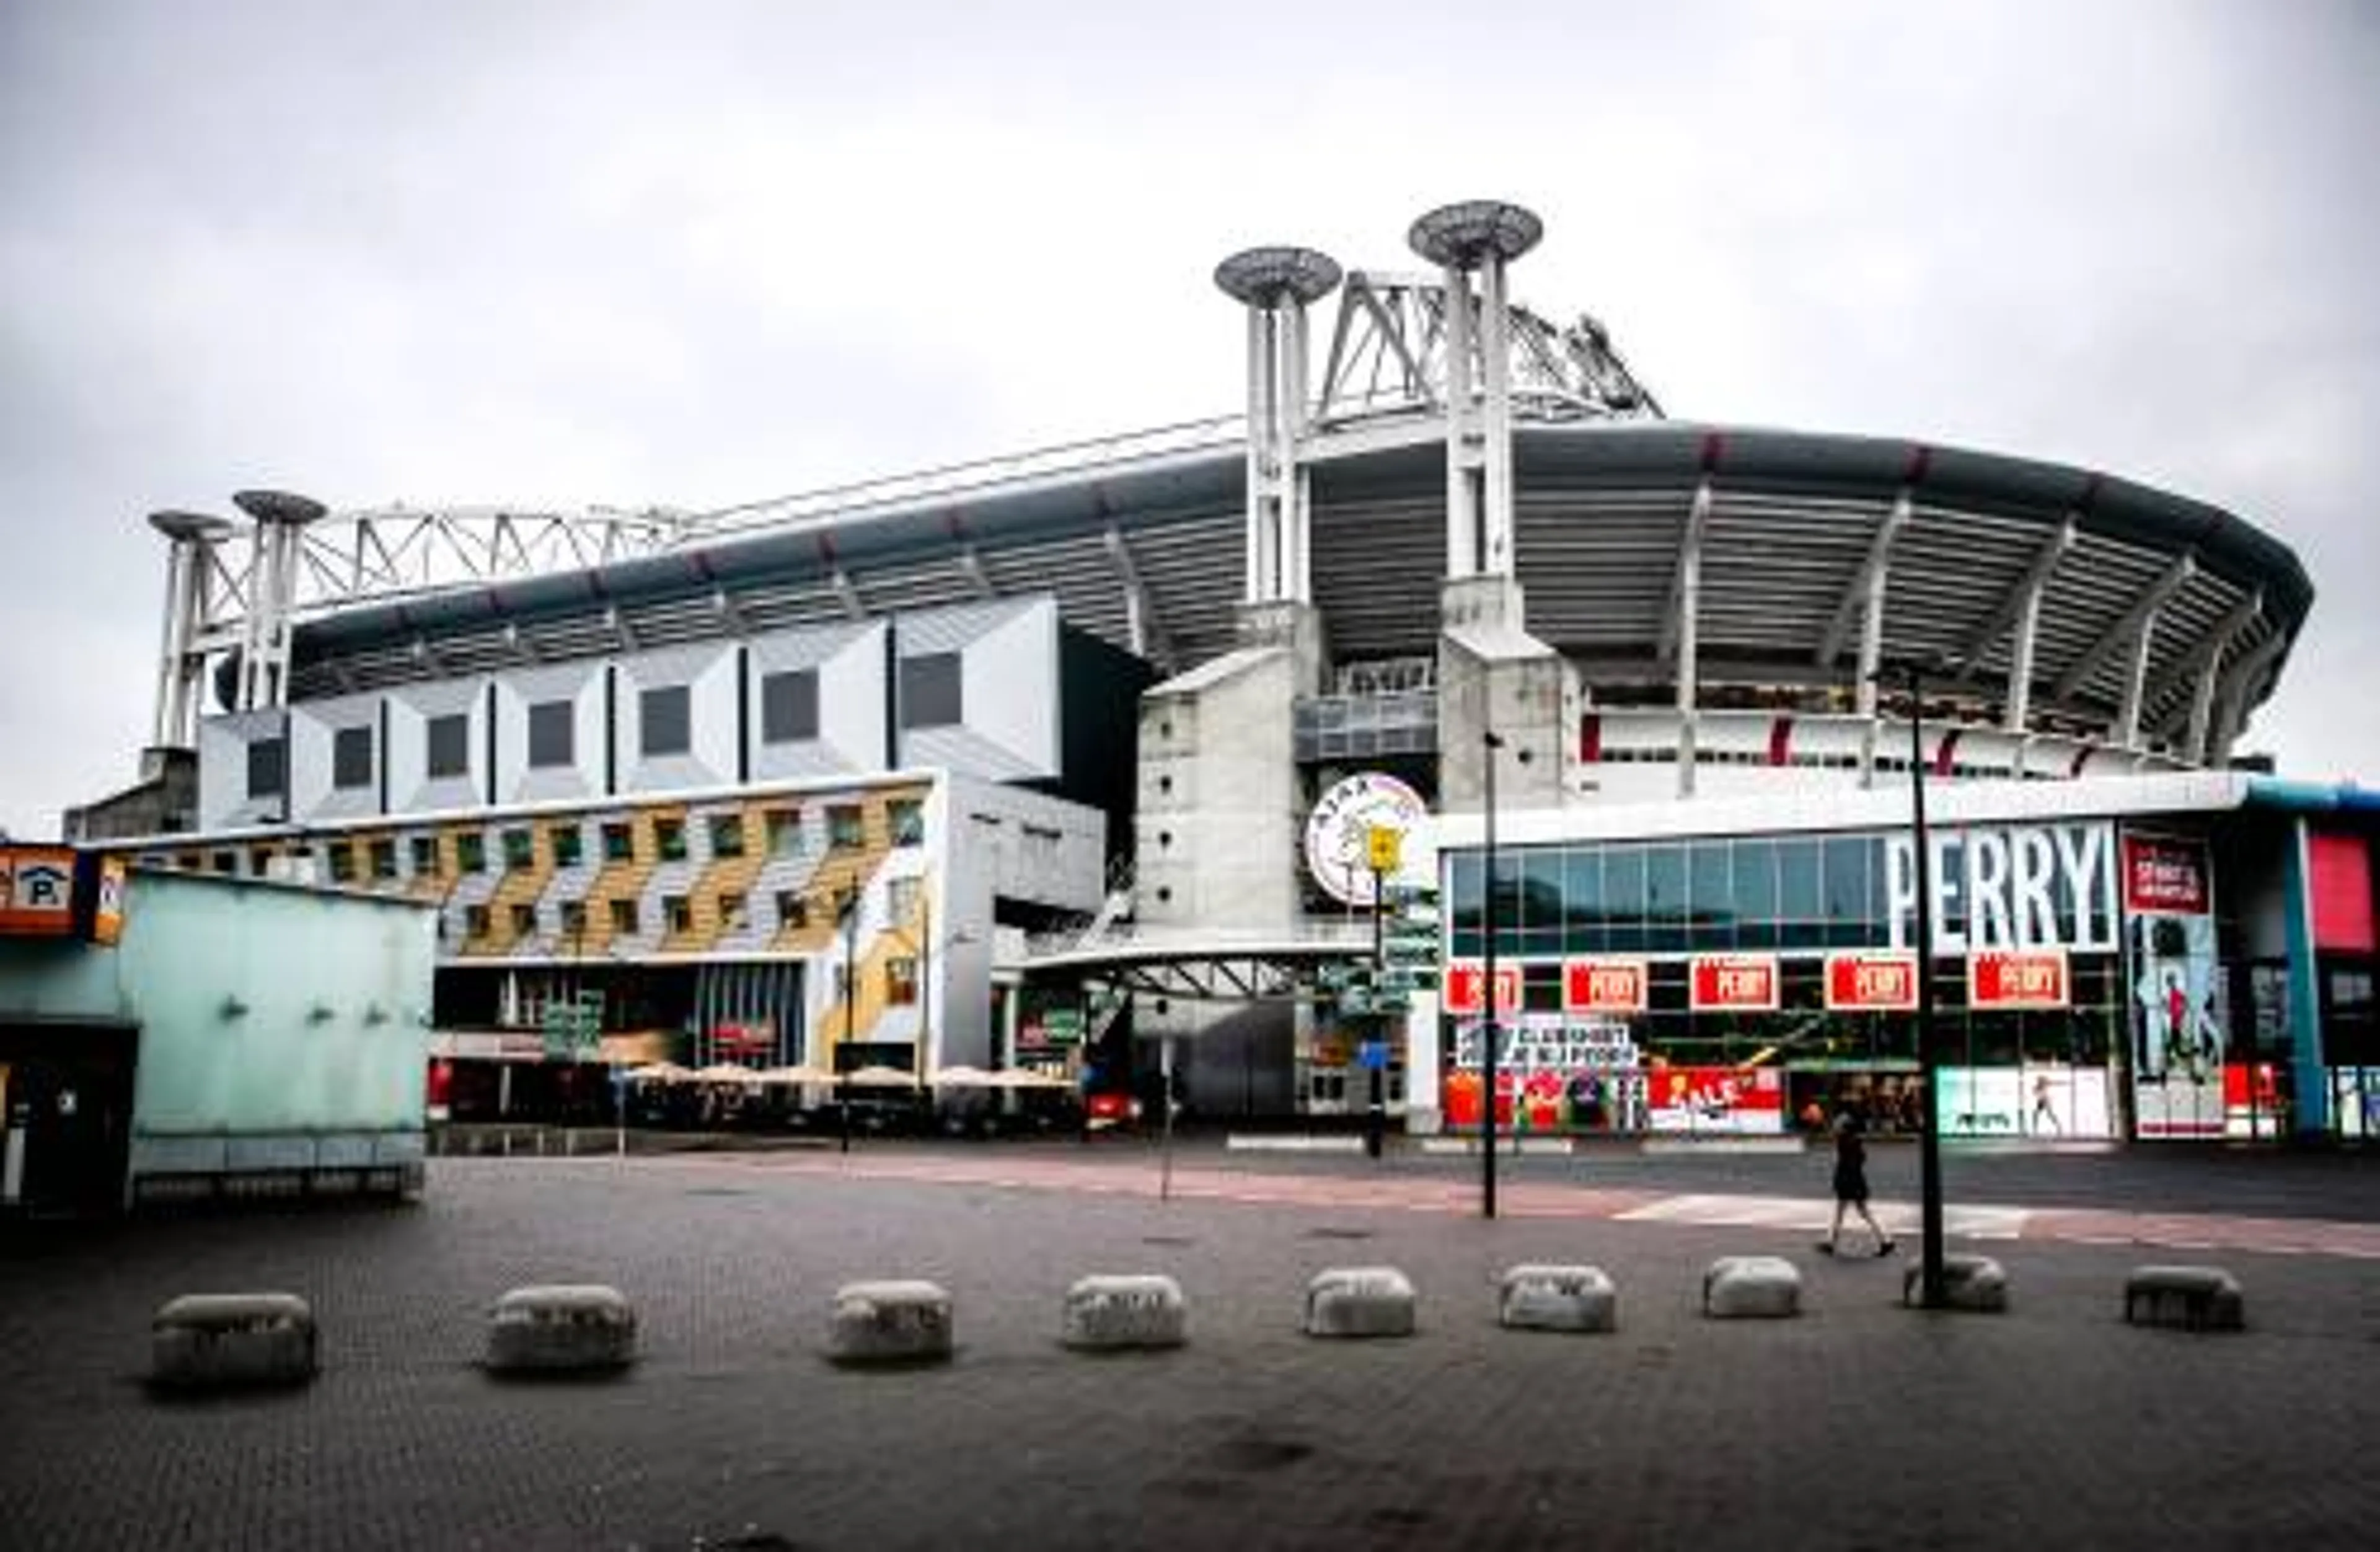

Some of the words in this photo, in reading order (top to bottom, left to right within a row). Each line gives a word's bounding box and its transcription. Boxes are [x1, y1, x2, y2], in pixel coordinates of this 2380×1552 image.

[1886, 827, 2102, 953] PERRY
[1589, 969, 1634, 999] PERRY
[1718, 968, 1766, 999] PERRY
[1857, 965, 1903, 997] PERRY
[1999, 963, 2055, 994] PERRY
